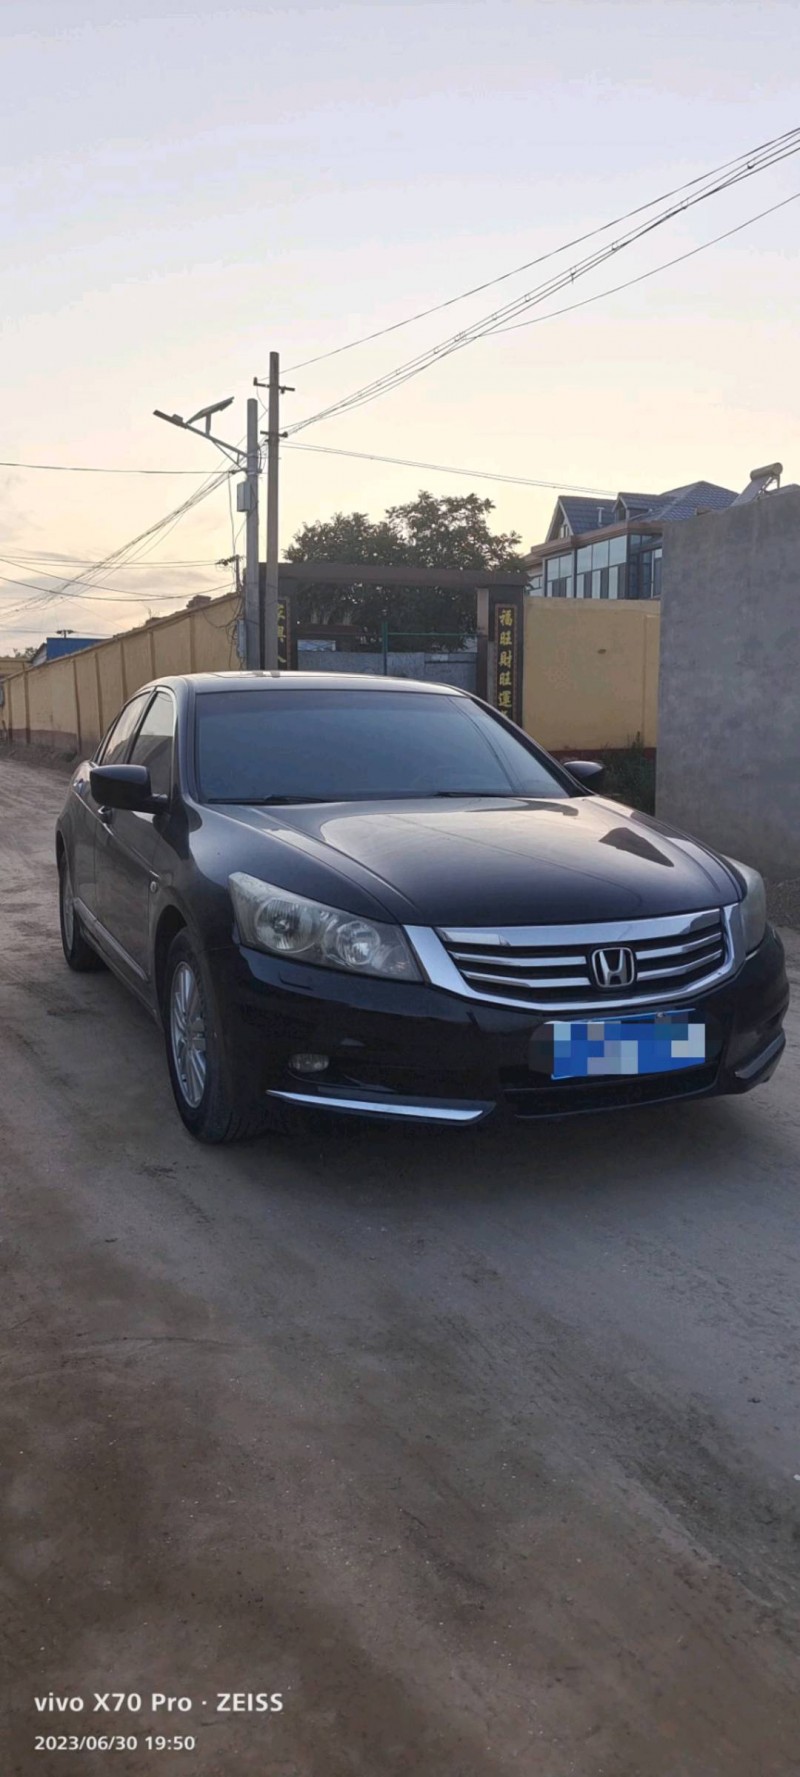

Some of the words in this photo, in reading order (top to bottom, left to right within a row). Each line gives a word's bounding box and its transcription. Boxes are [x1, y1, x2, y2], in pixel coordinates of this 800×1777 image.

[499, 609, 512, 717] 福旺財旺運
